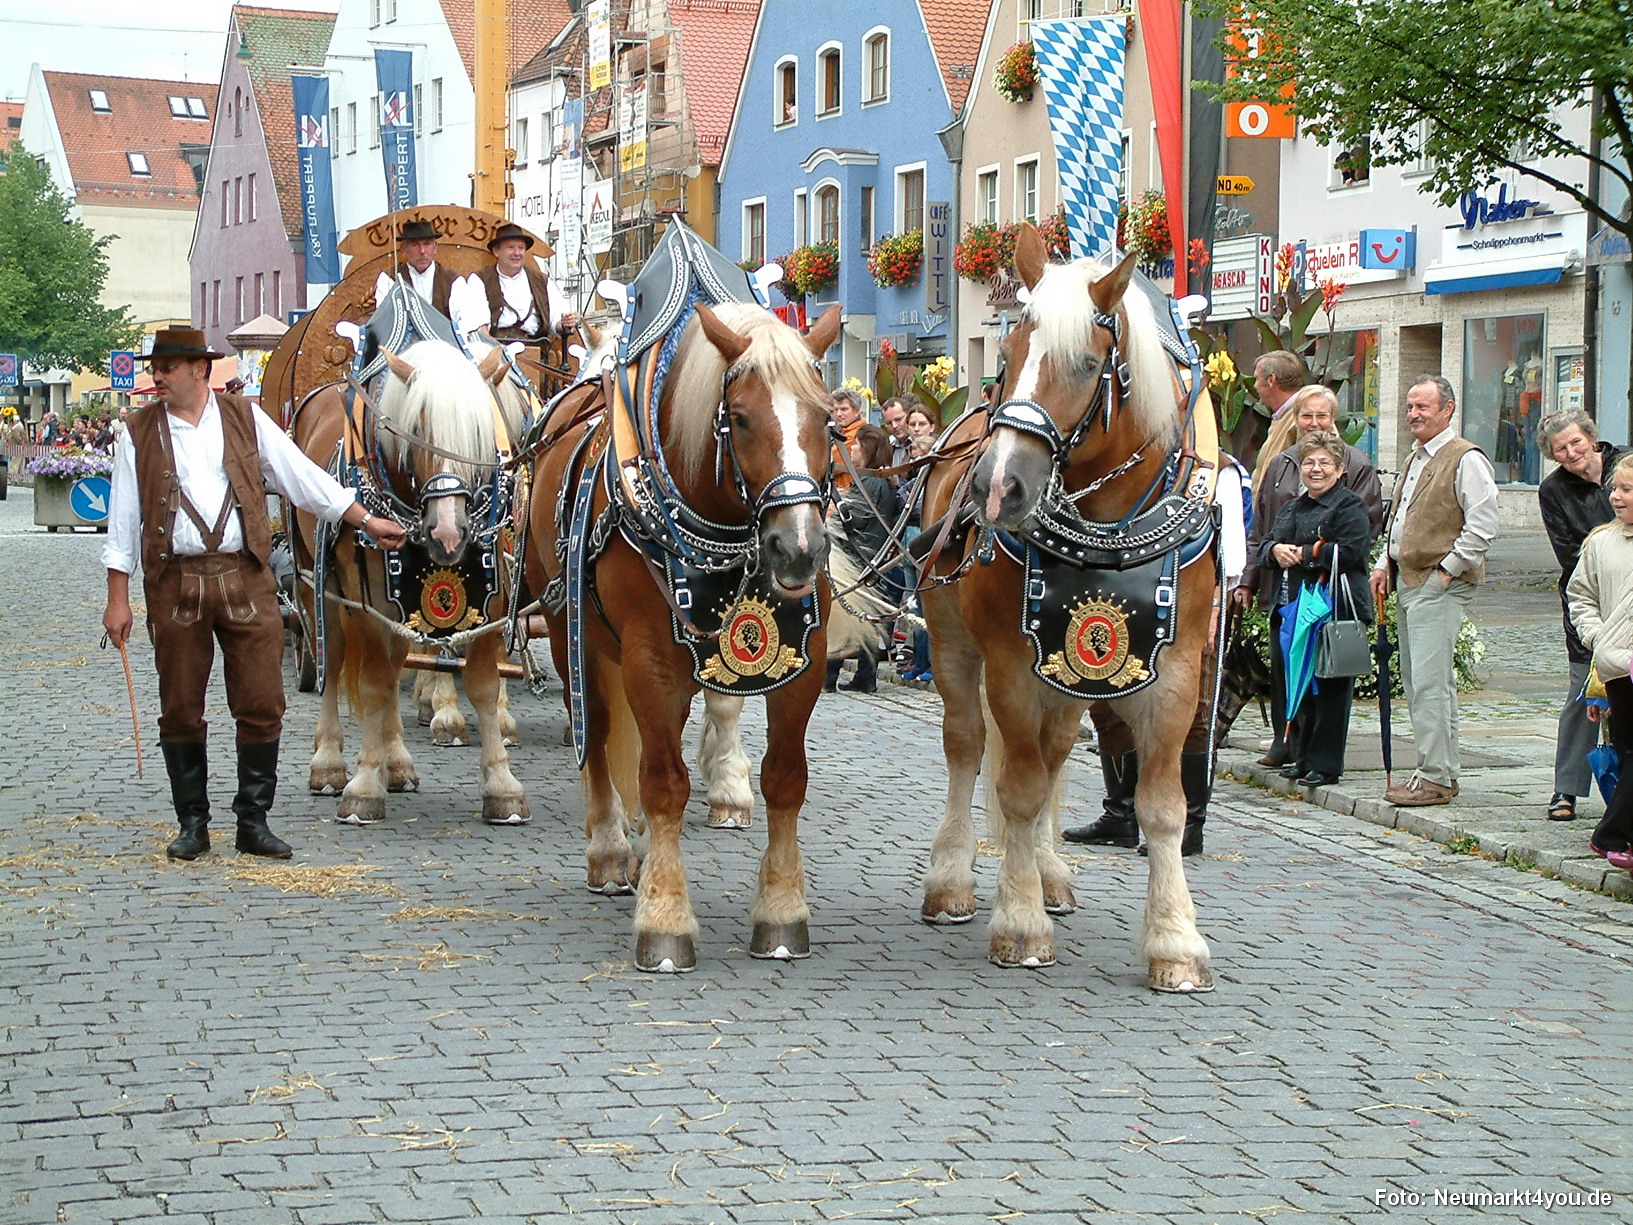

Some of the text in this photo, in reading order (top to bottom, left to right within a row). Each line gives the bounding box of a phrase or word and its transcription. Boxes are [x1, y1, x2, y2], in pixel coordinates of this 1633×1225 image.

[1217, 179, 1232, 191] NO
[520, 195, 545, 218] HOTEL
[1472, 233, 1544, 250] Schnäppchenmarkt
[931, 223, 946, 305] WITTL
[1306, 246, 1345, 273] chielein
[1213, 270, 1246, 289] AGASCAR
[1260, 239, 1270, 313] KINO
[113, 377, 133, 387] TAXI
